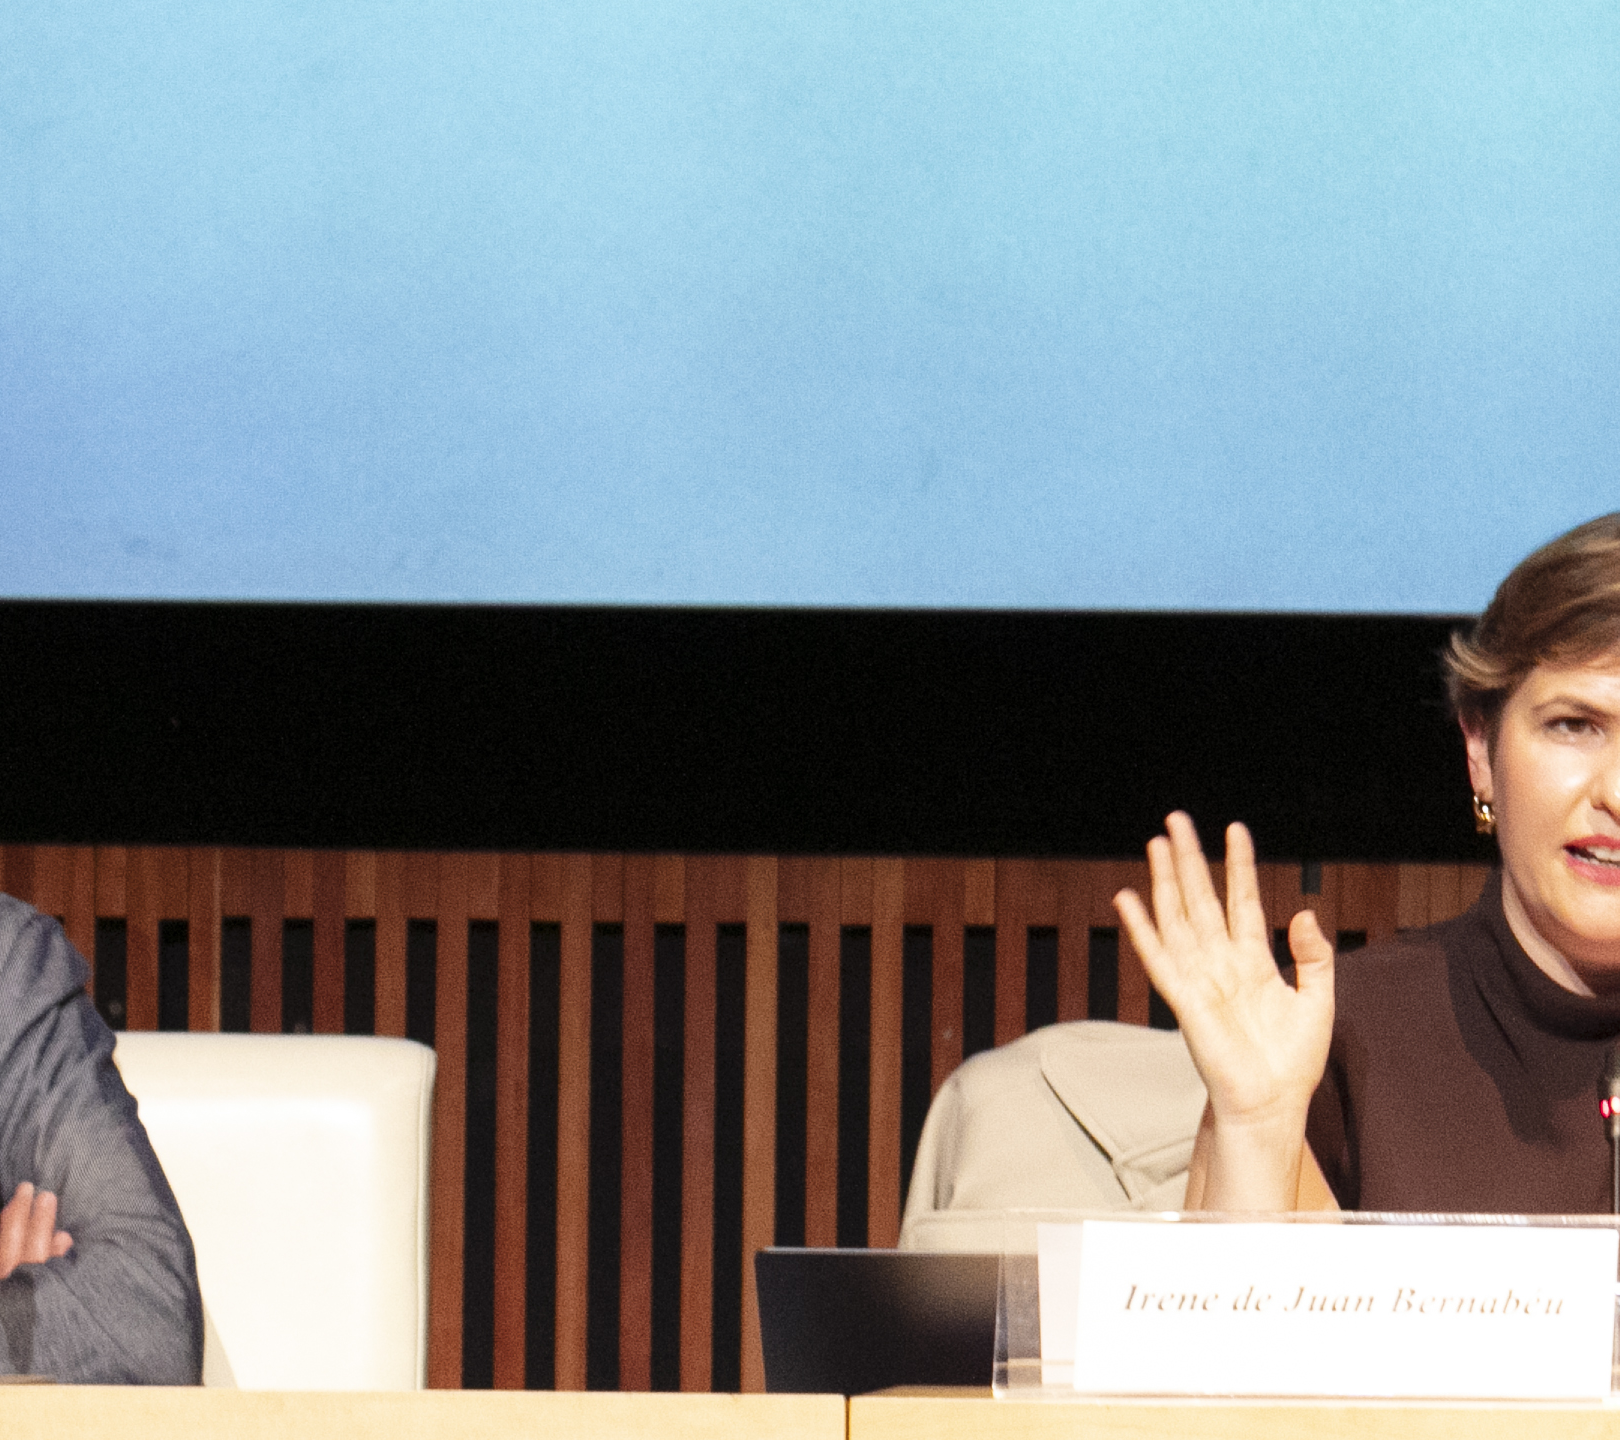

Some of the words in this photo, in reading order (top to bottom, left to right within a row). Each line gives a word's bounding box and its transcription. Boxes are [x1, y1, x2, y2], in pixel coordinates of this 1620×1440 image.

[1123, 1283, 1220, 1313] Irene
[1231, 1284, 1273, 1313] de
[1282, 1285, 1376, 1314] Juan
